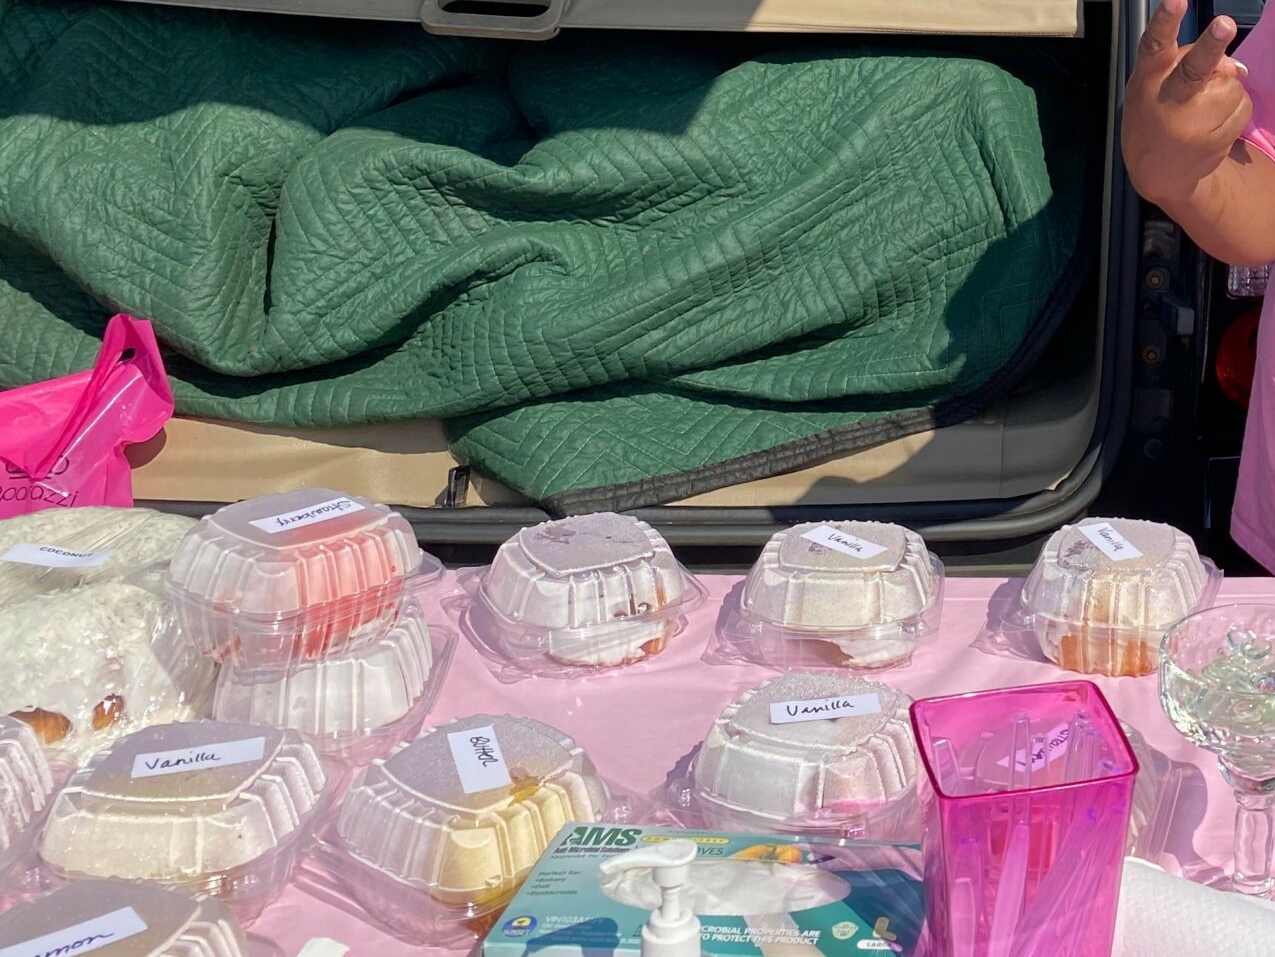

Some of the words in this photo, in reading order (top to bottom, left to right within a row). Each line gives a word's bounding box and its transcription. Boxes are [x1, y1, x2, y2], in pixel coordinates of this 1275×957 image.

[40, 546, 94, 559] COCONUT
[786, 699, 855, 716] Vanilla
[145, 750, 222, 770] Vanilla
[560, 826, 642, 846] AMS
[711, 933, 751, 943] PROTECT
[752, 935, 771, 944] THIS
[774, 936, 819, 945] PRODUCT
[744, 928, 800, 937] PROPERTIES
[801, 930, 821, 938] ARE
